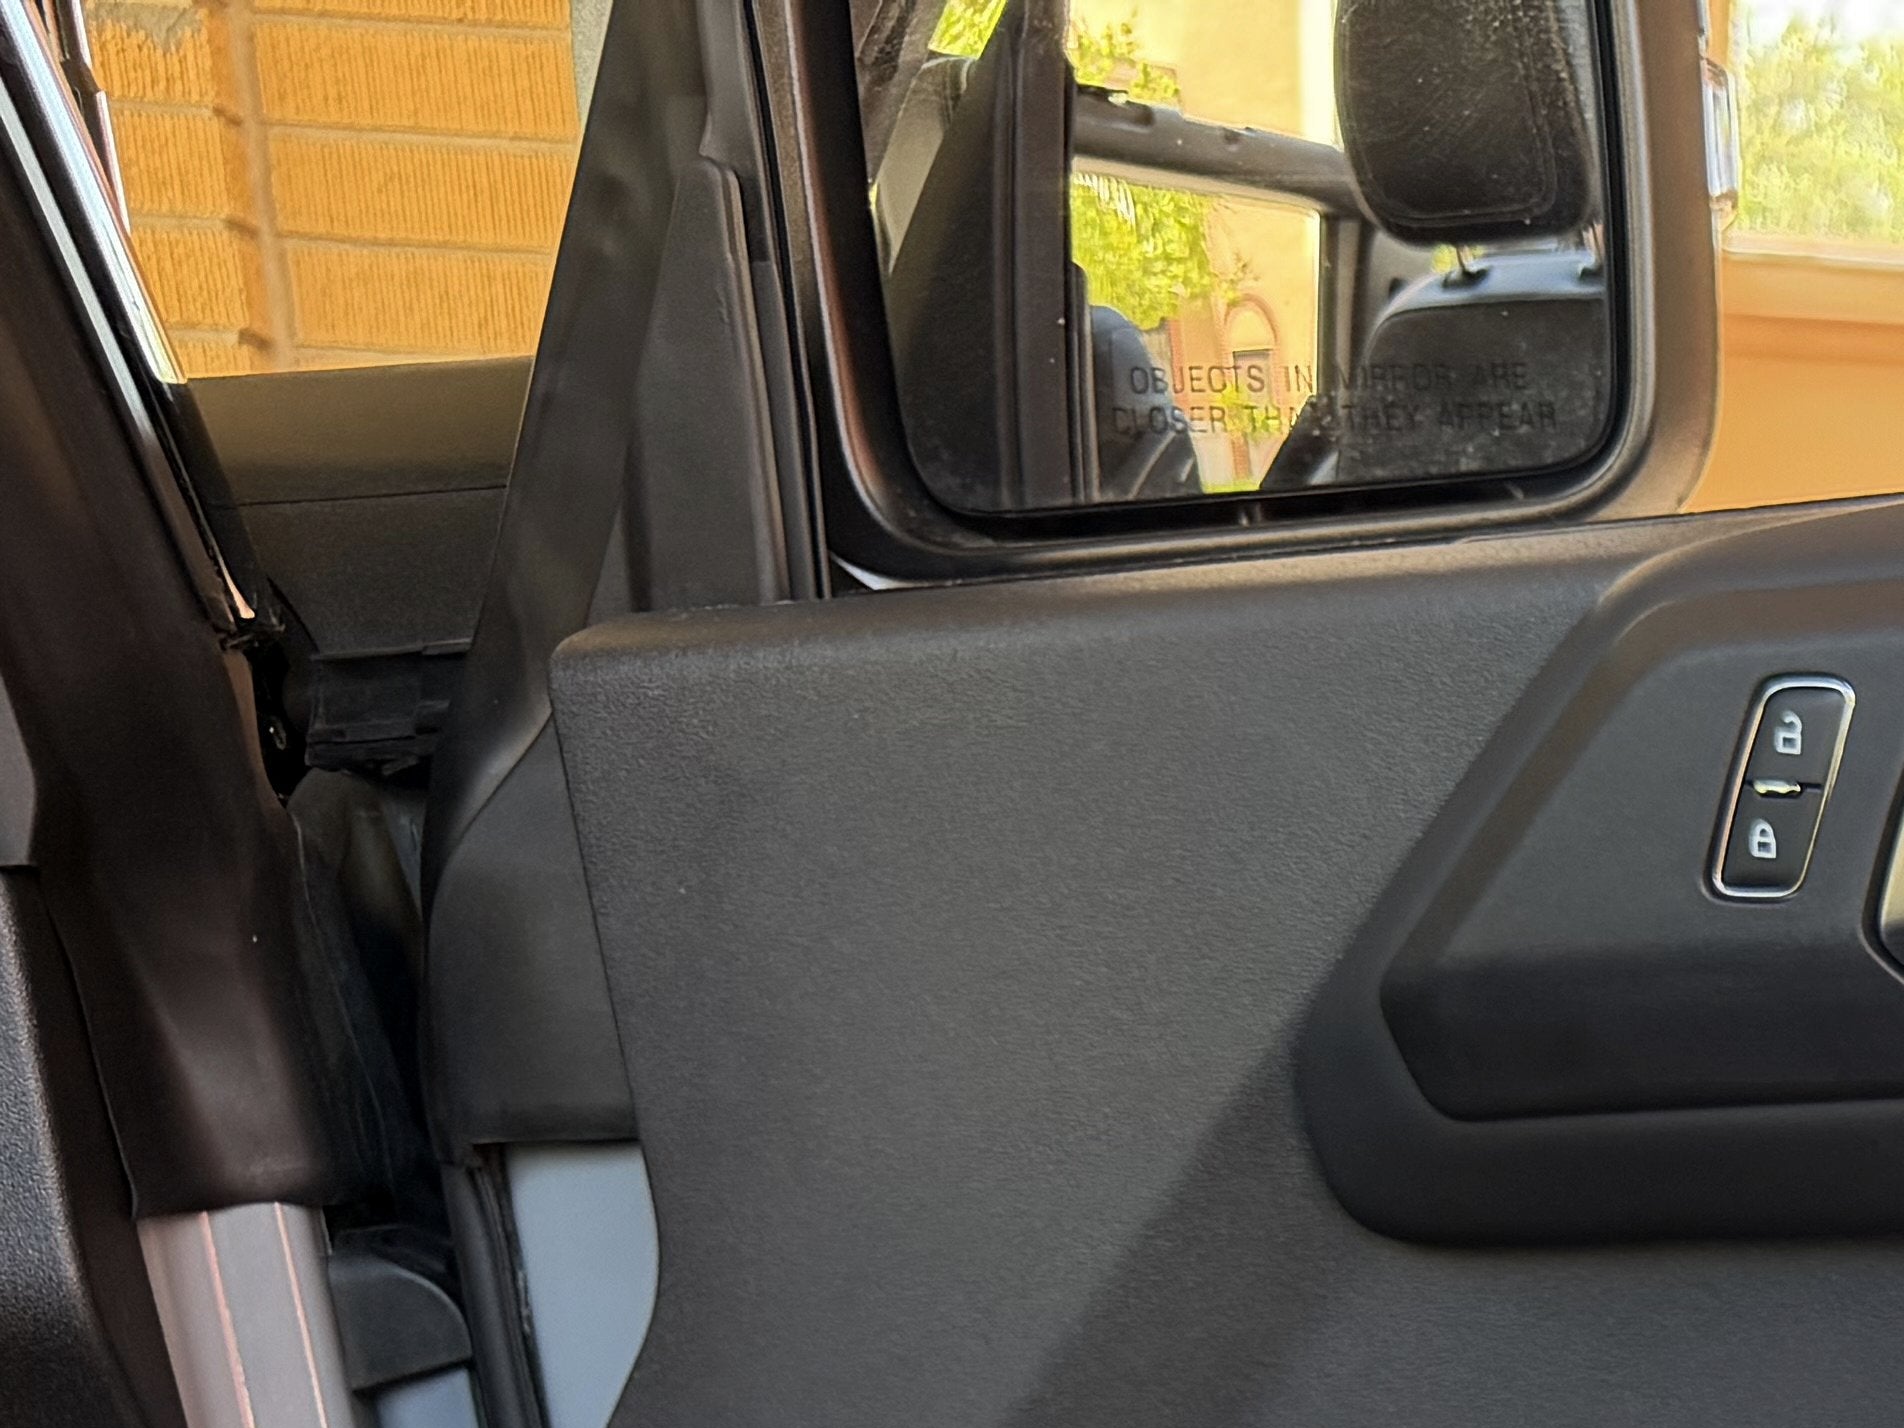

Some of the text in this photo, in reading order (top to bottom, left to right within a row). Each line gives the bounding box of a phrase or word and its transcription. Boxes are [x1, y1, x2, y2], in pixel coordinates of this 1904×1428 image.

[1130, 364, 1265, 394] OBJECTS
[1282, 364, 1313, 393] IN
[1111, 405, 1228, 434] CLOSER
